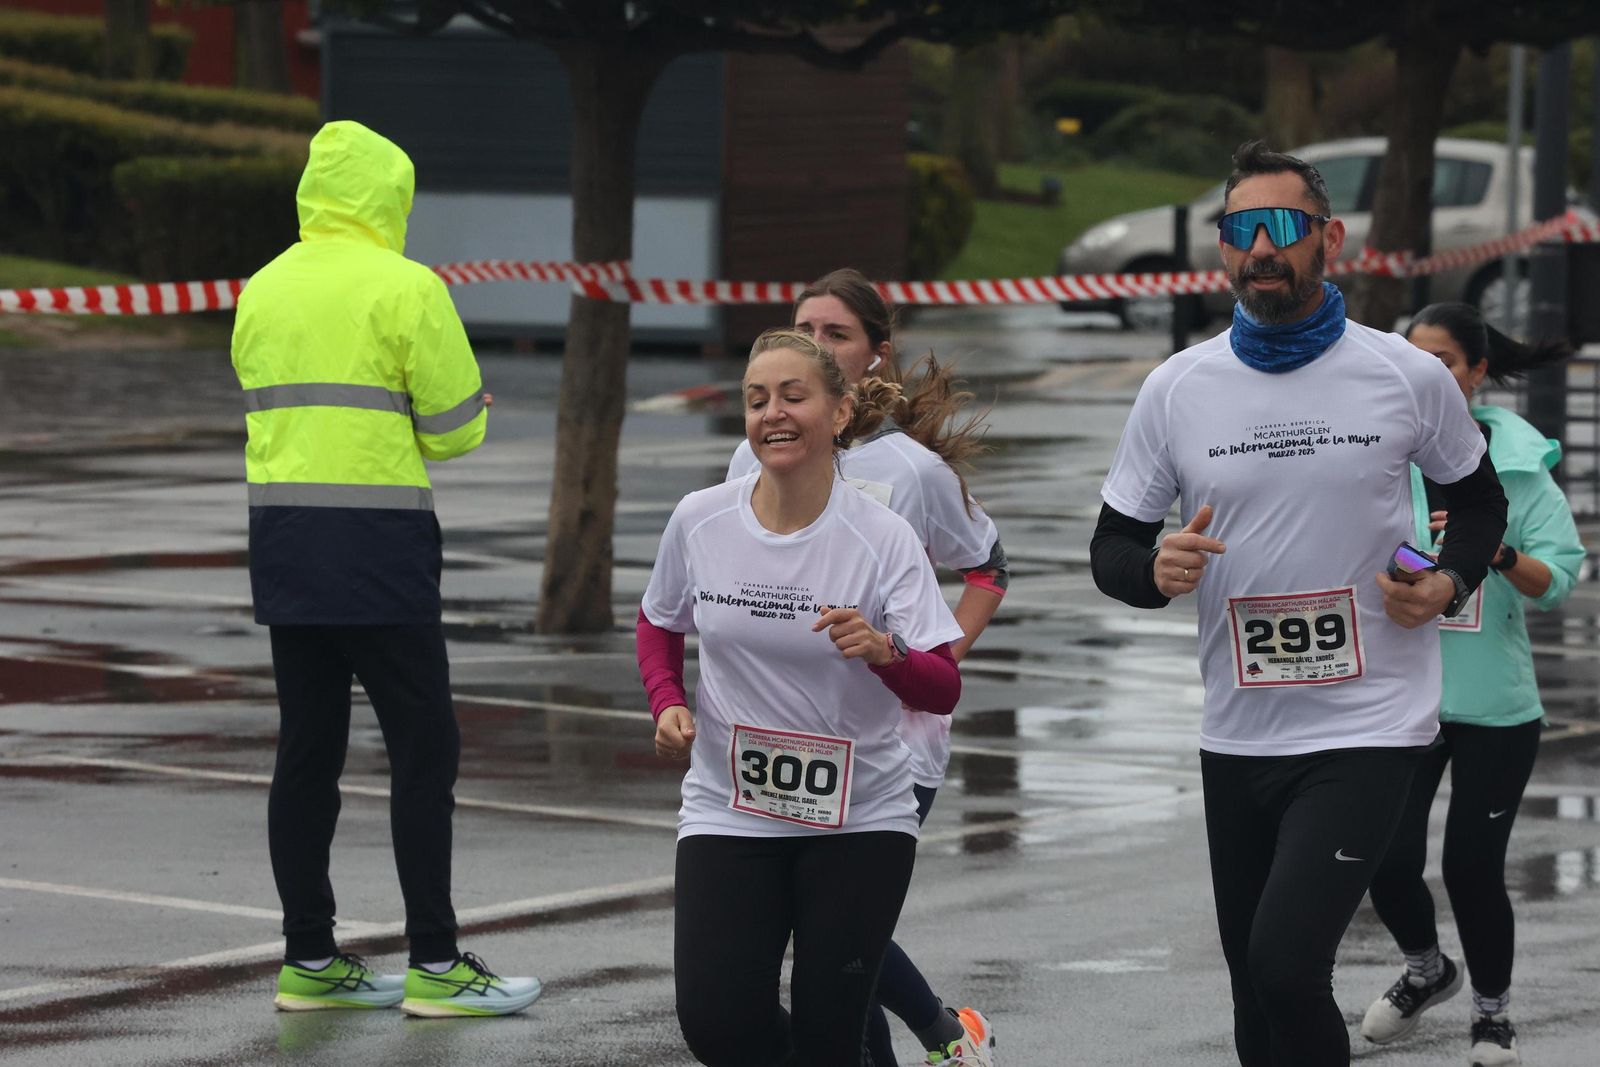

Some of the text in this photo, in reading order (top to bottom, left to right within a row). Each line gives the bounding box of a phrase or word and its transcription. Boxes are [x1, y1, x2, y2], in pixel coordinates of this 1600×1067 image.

[1208, 434, 1382, 458] Día Internacional de la Mujer
[1297, 447, 1316, 456] 2025
[700, 590, 715, 602] Día
[716, 593, 797, 613] Internacional
[797, 602, 812, 612] de
[1259, 606, 1301, 614] INTERNACIONAL
[779, 612, 796, 620] 2025
[1244, 613, 1347, 655] 299
[1315, 653, 1335, 662] ANDRÉS
[748, 733, 771, 742] CARRERA
[758, 740, 798, 752] INTERNACIONAL
[815, 748, 833, 756] MUJER
[741, 749, 838, 797] 300
[801, 797, 818, 806] ISABEL
